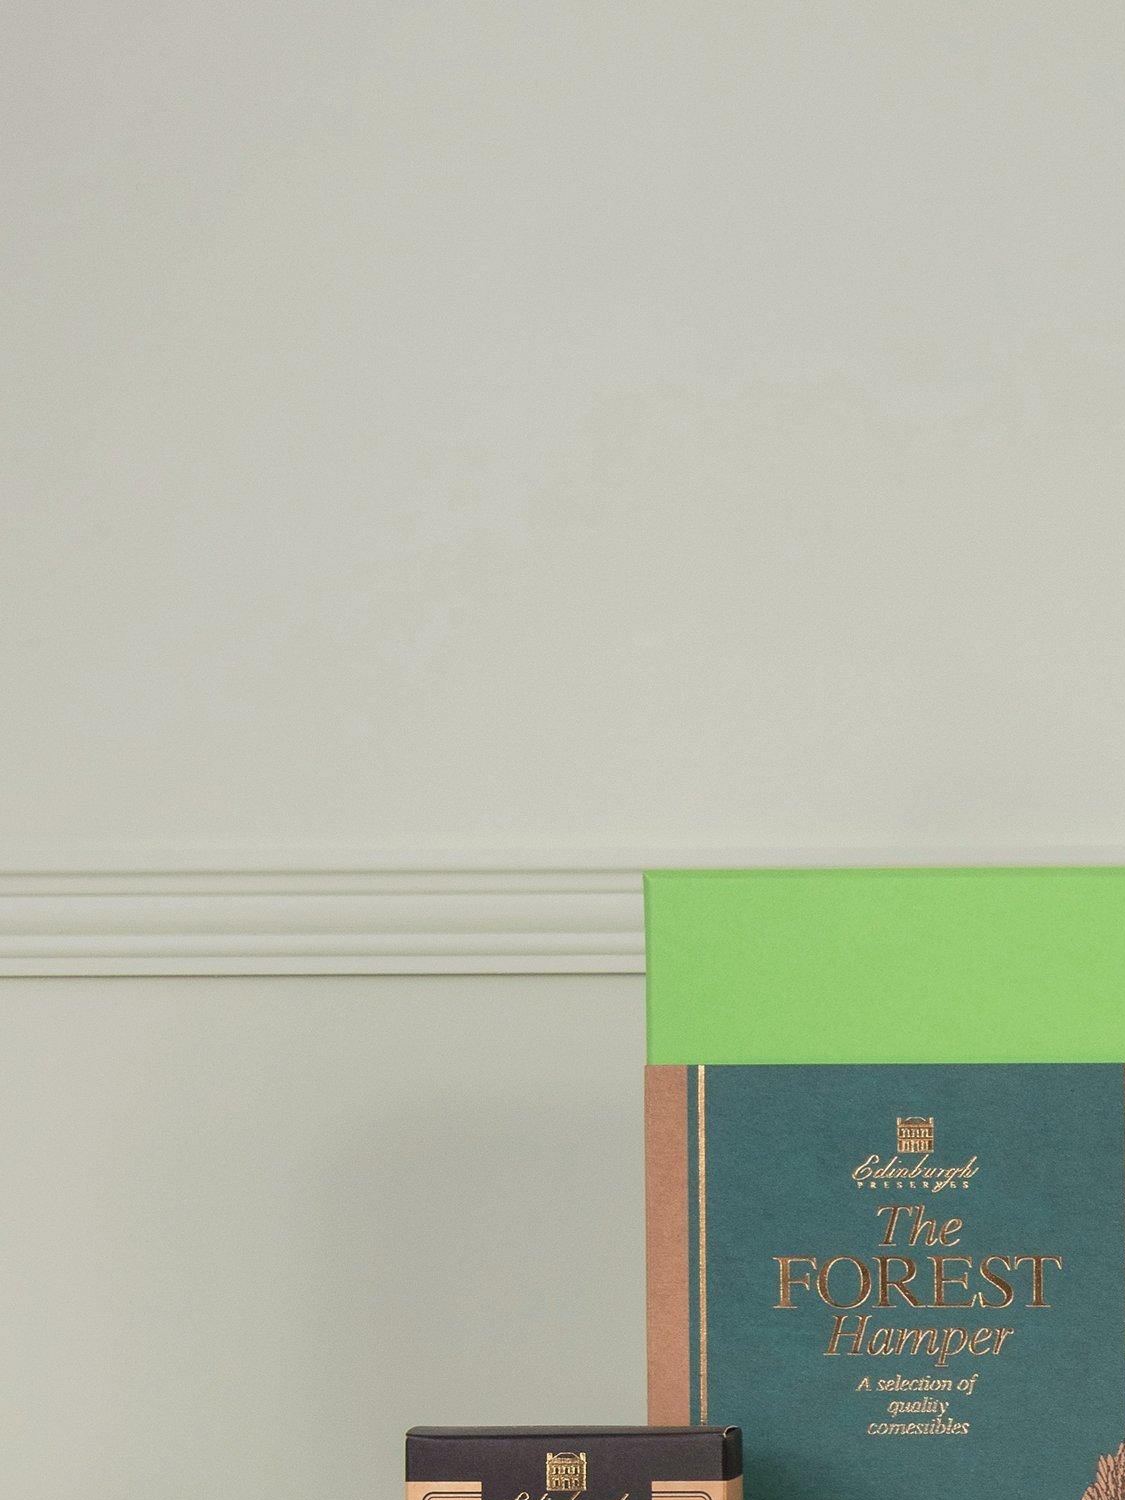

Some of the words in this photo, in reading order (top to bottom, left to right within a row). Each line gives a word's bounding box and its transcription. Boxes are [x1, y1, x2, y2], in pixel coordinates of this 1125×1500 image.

[852, 1153, 979, 1193] Edinburgh
[877, 1204, 963, 1248] The
[772, 1255, 1063, 1309] FOREST
[824, 1314, 1015, 1367] Hamper
[855, 1376, 871, 1392] A
[877, 1375, 953, 1392] selection
[957, 1373, 979, 1395] of
[887, 1396, 949, 1416] quality
[867, 1418, 971, 1436] comestibles
